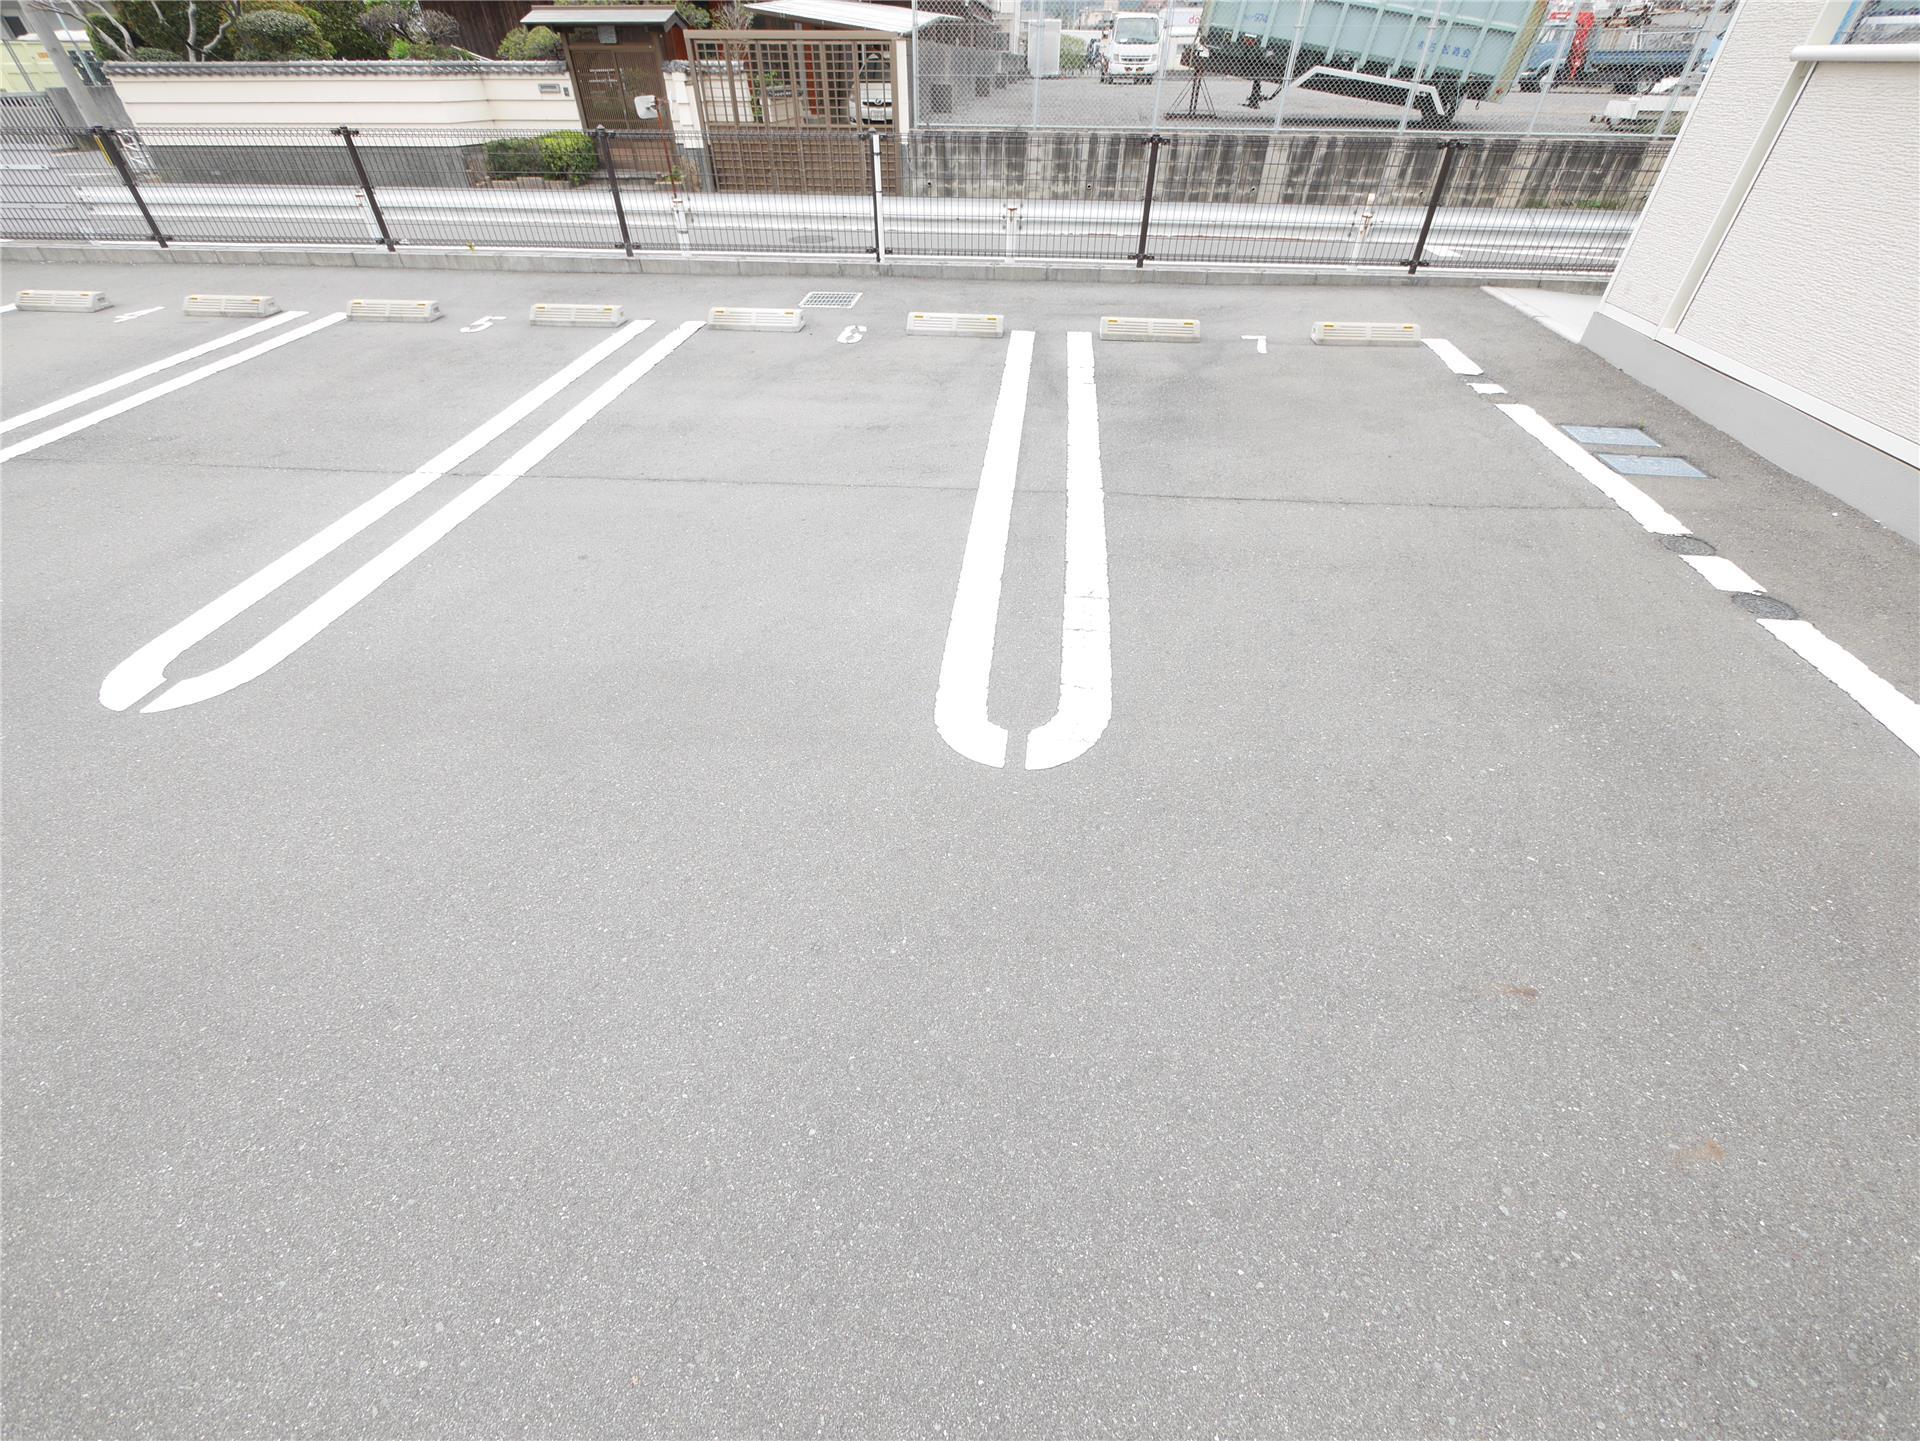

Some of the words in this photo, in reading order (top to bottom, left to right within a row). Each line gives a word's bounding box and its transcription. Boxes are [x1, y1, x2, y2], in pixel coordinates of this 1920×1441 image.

[459, 315, 507, 333] 5
[836, 325, 867, 344] 6
[1240, 335, 1267, 354] 7
